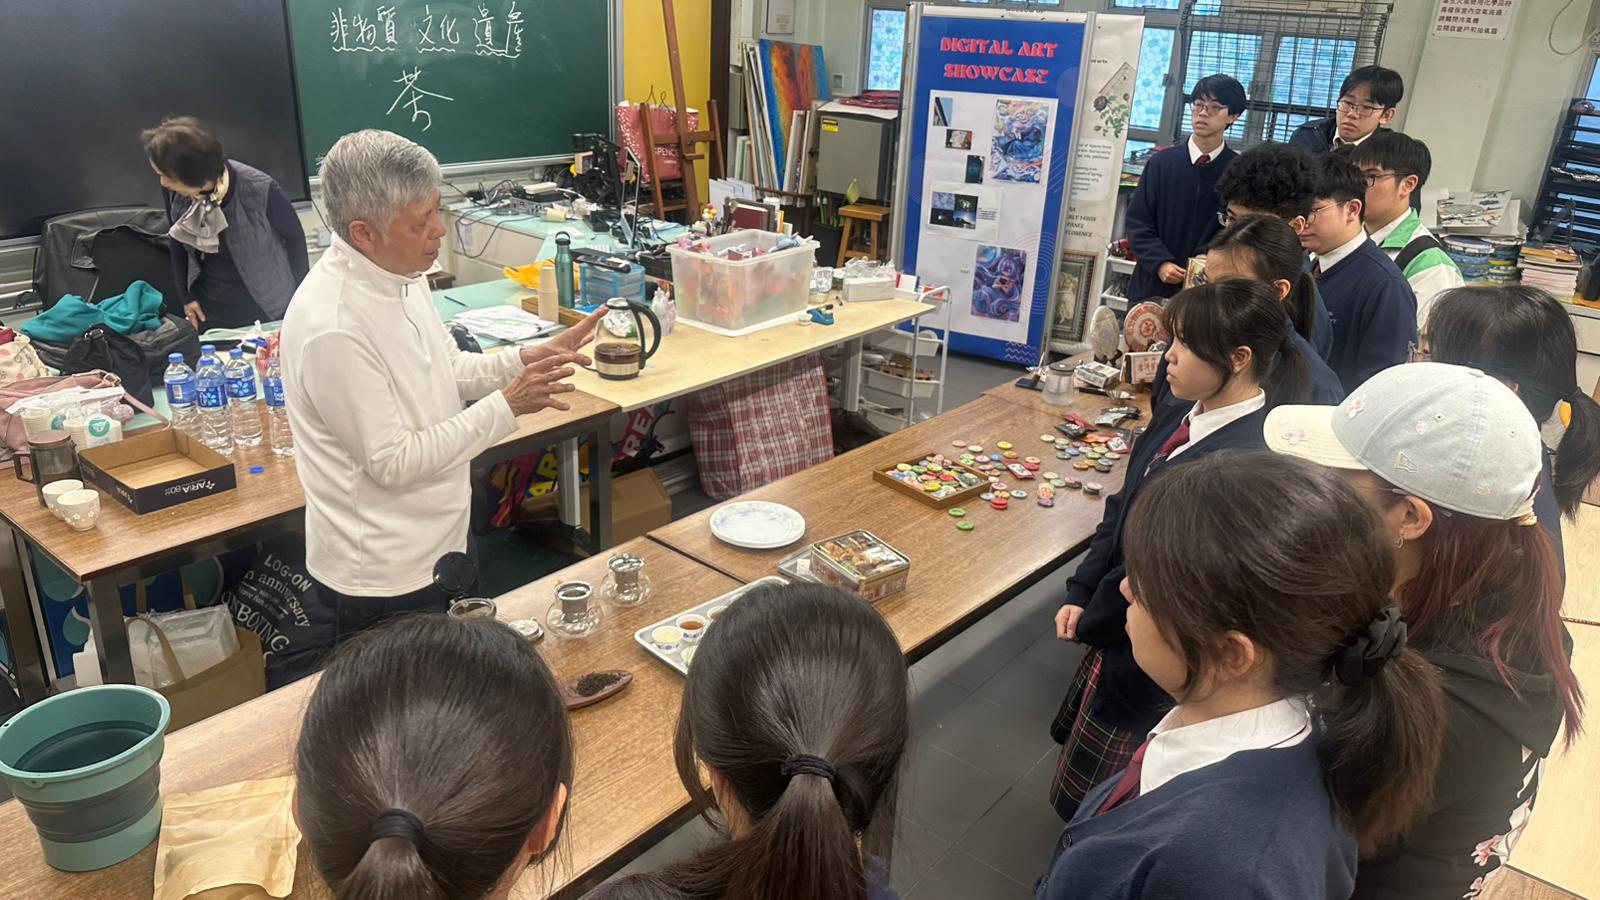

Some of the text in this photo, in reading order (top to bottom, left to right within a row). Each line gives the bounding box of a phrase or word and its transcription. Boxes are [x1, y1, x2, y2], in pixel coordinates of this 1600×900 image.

[331, 2, 525, 53] 非物質 文化 遺產
[940, 37, 1058, 58] DIGITAL ART
[944, 64, 1050, 85] SHOWCASE
[385, 67, 454, 132] 茶
[264, 554, 313, 592] LOG-ON
